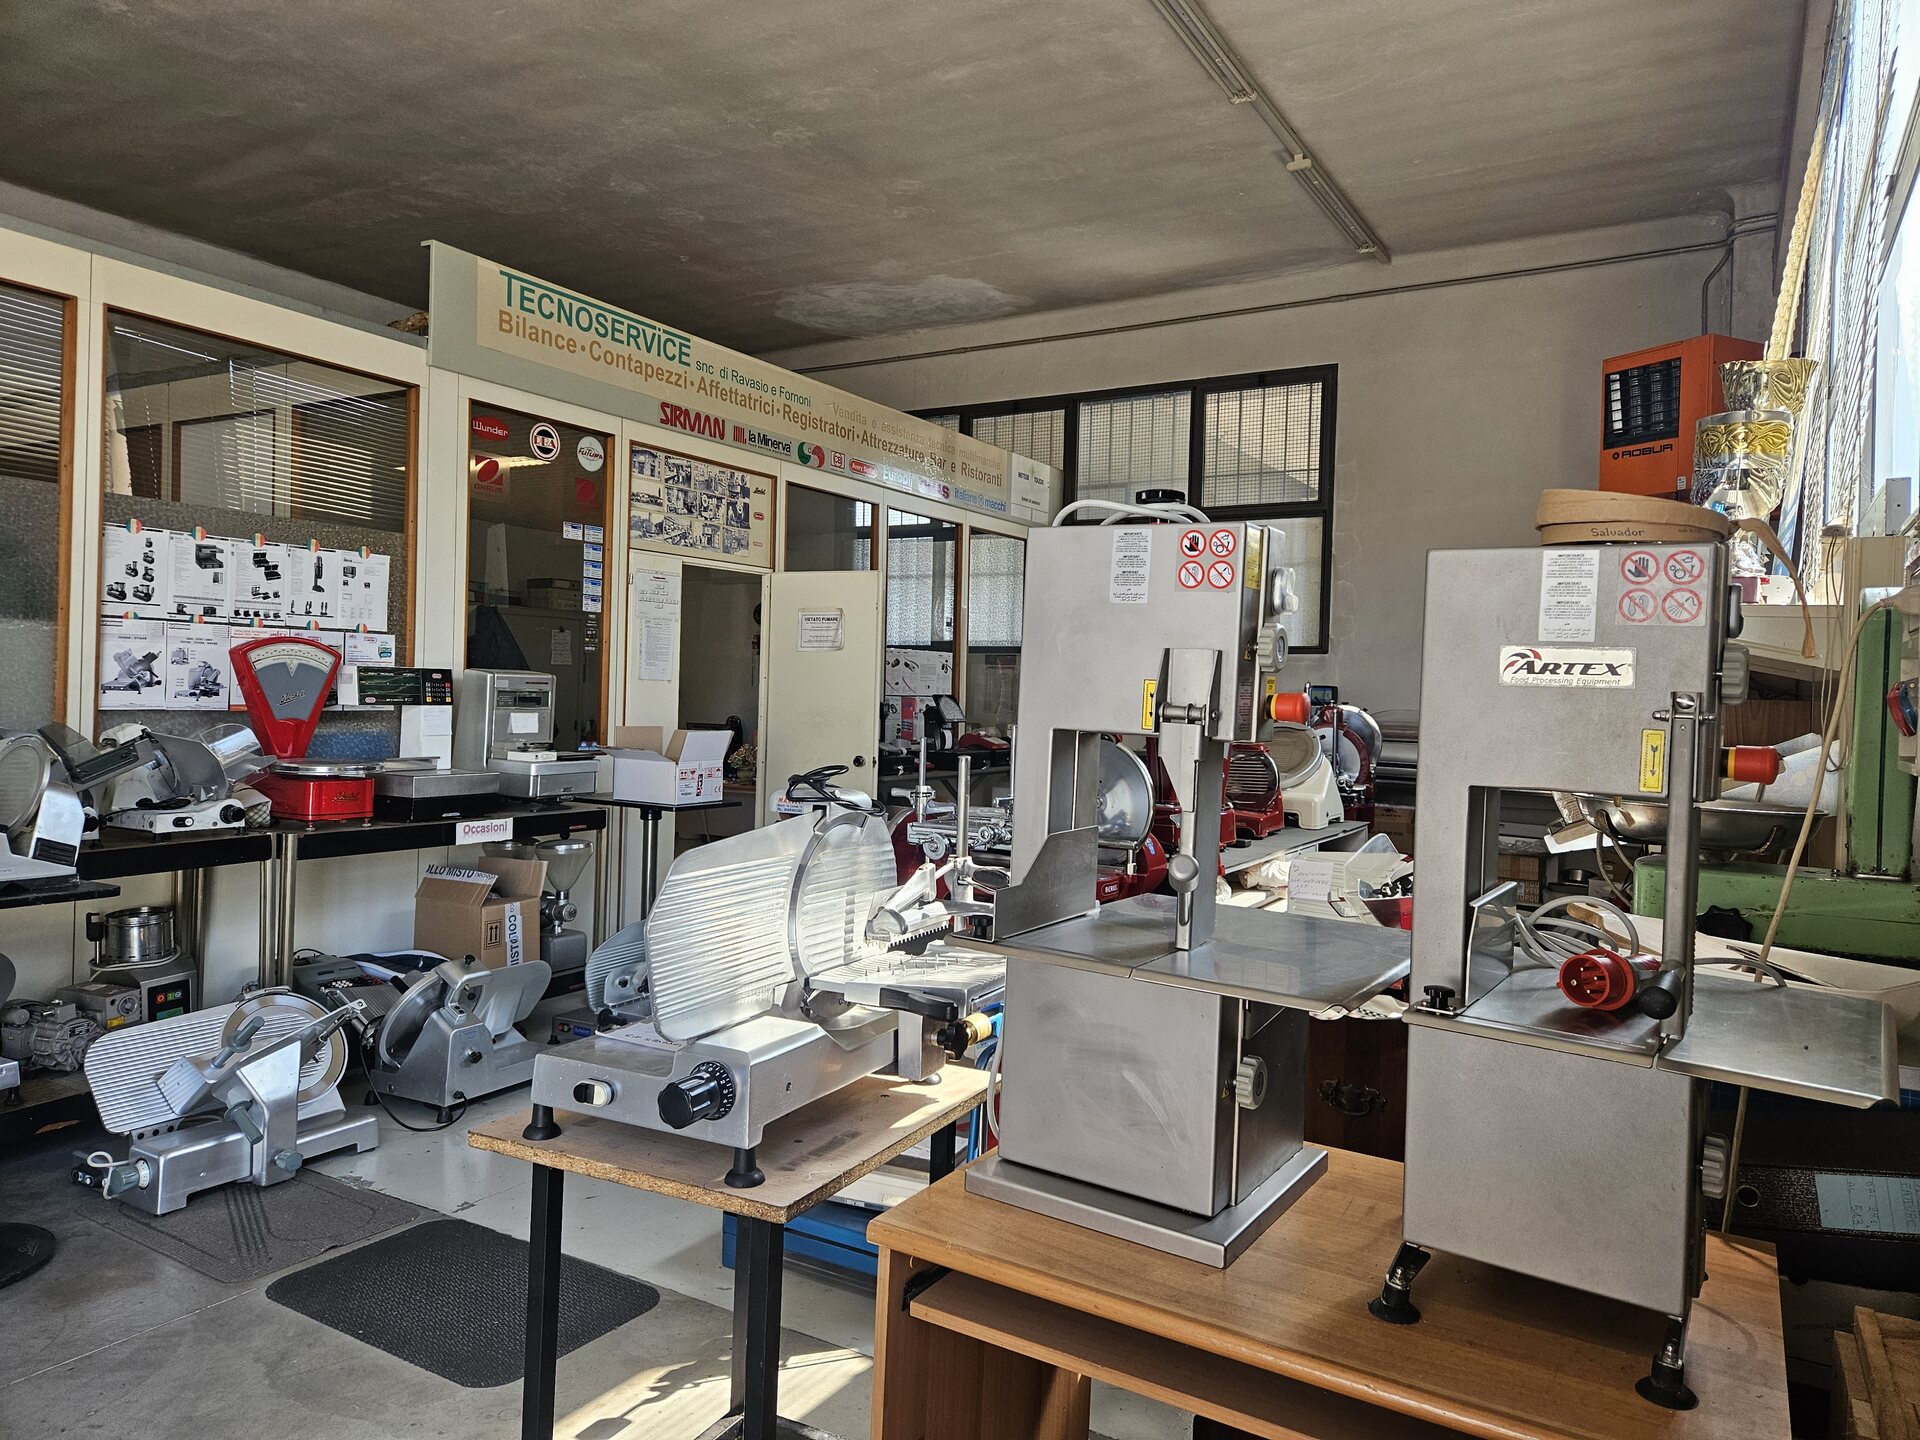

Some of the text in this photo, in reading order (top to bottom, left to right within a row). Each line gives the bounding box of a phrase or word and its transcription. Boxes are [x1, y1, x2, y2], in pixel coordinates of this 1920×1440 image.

[696, 360, 811, 408] snc di Ravasio e Fornoni
[472, 420, 509, 437] Wunder
[660, 401, 726, 441] SIRMAN
[832, 402, 867, 426] Vendita
[871, 420, 877, 429] e
[882, 422, 925, 444] assistenza
[929, 438, 956, 455] tecnica
[748, 429, 791, 453] la Minerva
[1621, 443, 1673, 459] ROBUR
[951, 462, 956, 473] e
[961, 462, 1002, 487] Ristoranti
[1590, 527, 1645, 537] Salvador
[1511, 660, 1628, 676] ARTEX
[1510, 676, 1621, 686] Food Processing Equipment
[463, 821, 508, 835] Occasioni
